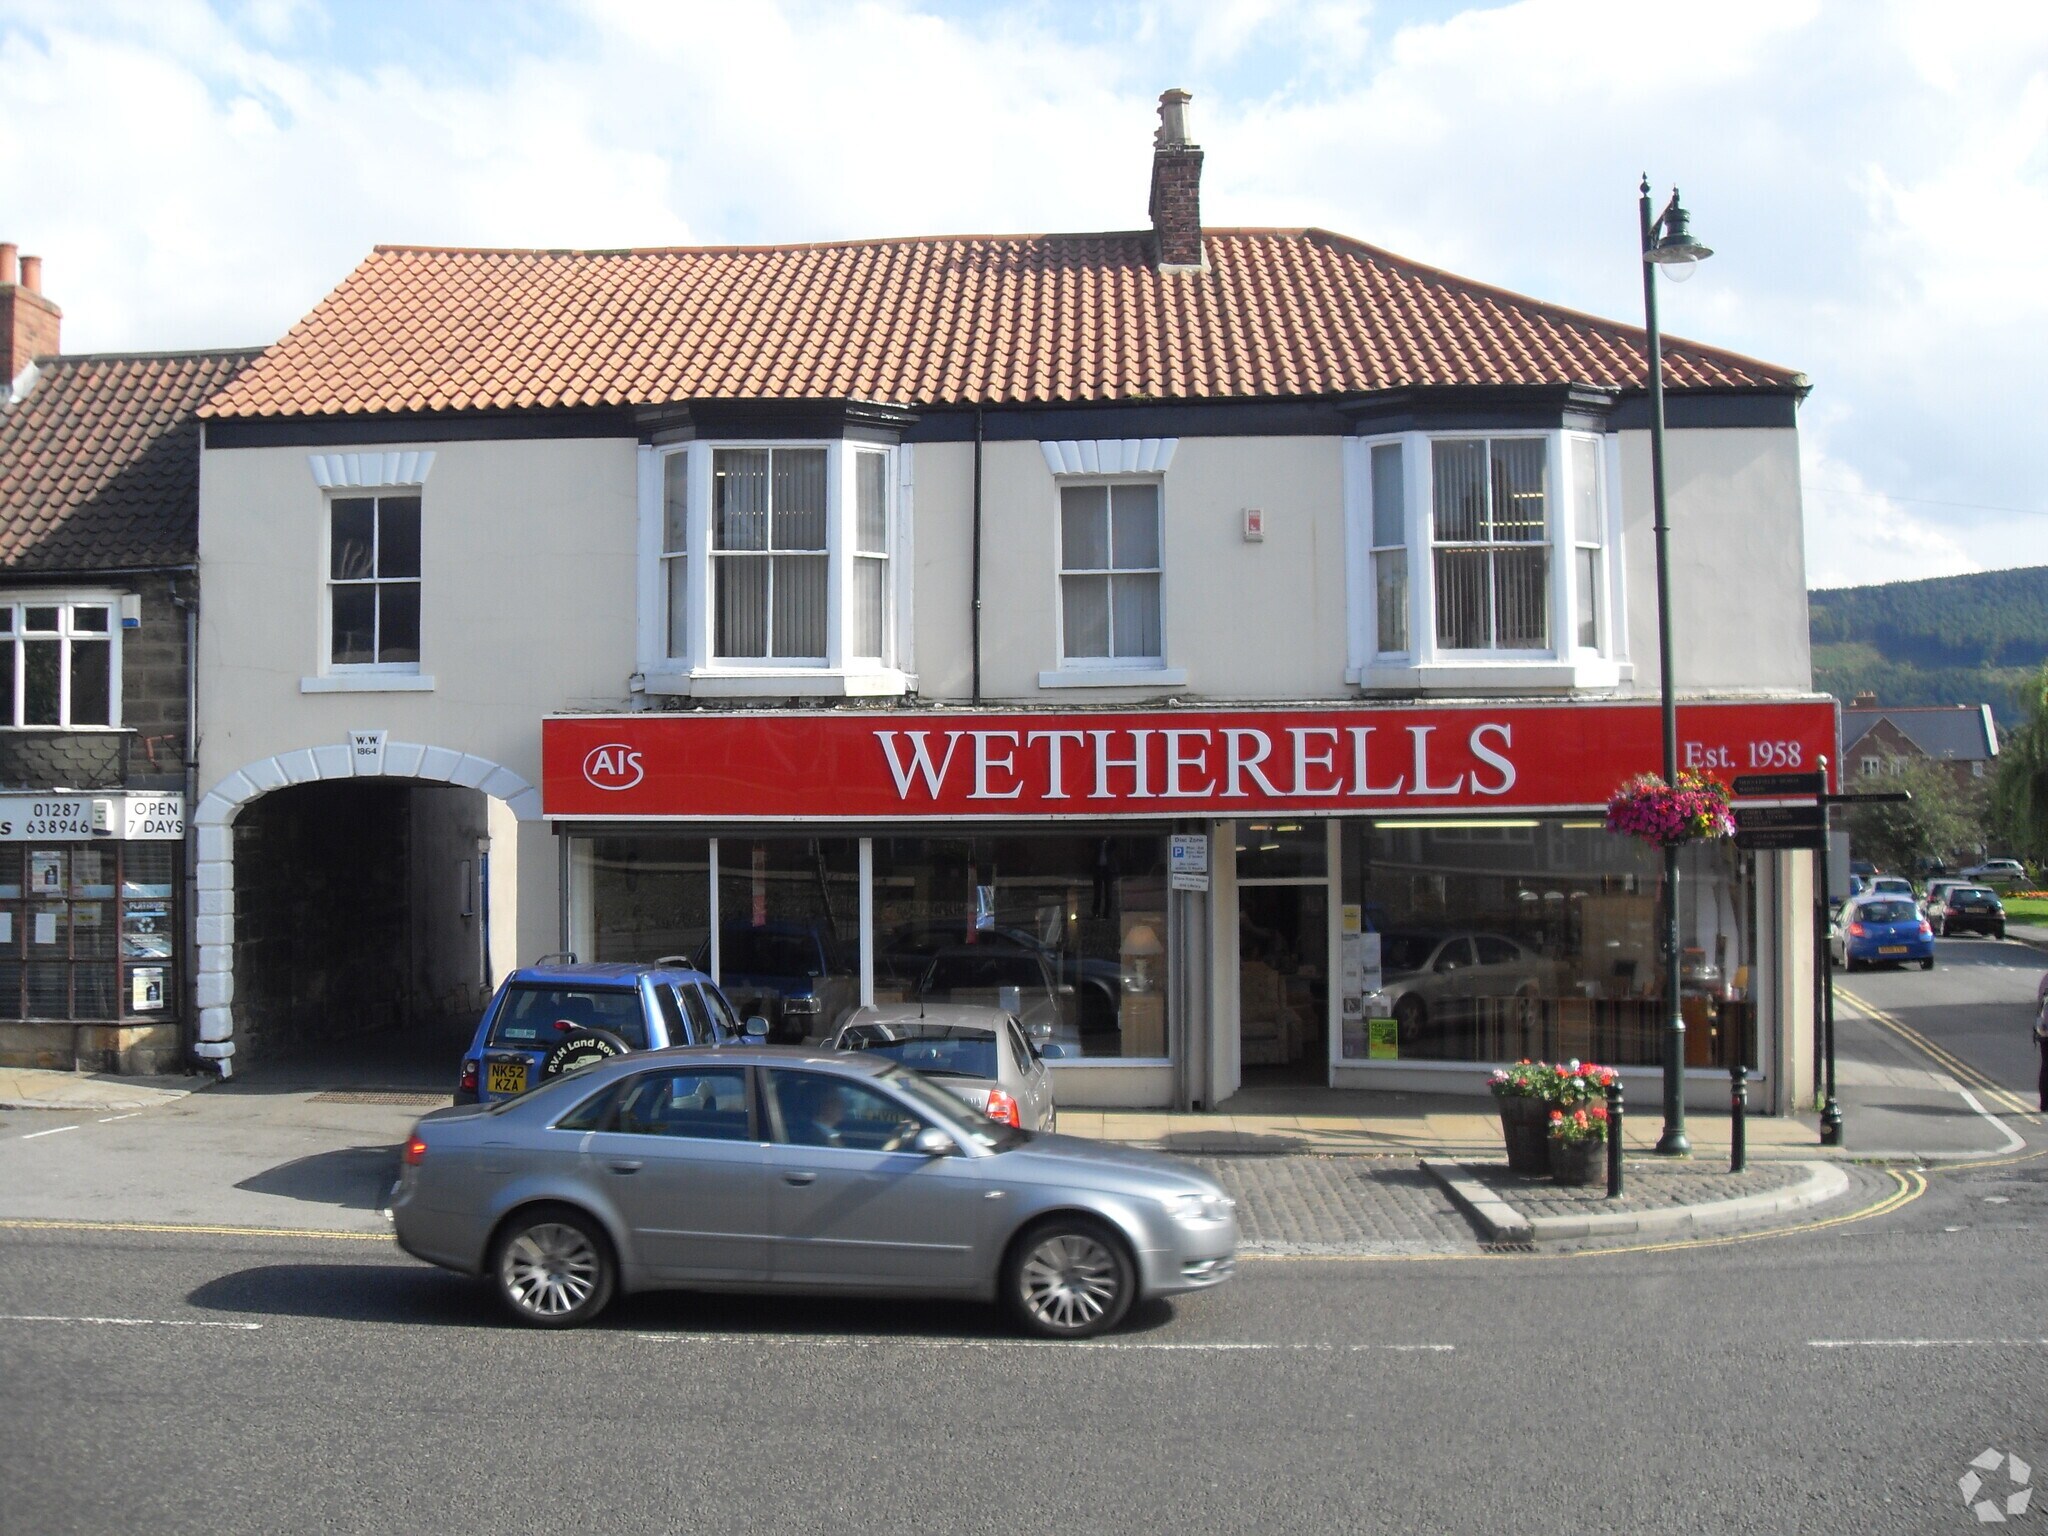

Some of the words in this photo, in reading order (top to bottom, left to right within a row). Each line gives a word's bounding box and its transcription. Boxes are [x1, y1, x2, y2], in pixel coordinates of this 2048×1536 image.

[357, 747, 377, 755] 1864
[1684, 741, 1736, 768] Est.
[1749, 740, 1801, 768] 1958
[587, 744, 644, 785] AIS
[873, 723, 1517, 800] WETHERELLS
[34, 803, 80, 817] 01287
[134, 803, 178, 815] OPEN
[26, 820, 89, 834] 638946
[128, 820, 135, 833] 7
[144, 820, 183, 833] DAYS
[567, 1038, 595, 1051] Land
[597, 1041, 615, 1057] Rov
[492, 1064, 524, 1079] NK52
[495, 1078, 519, 1092] KZA
